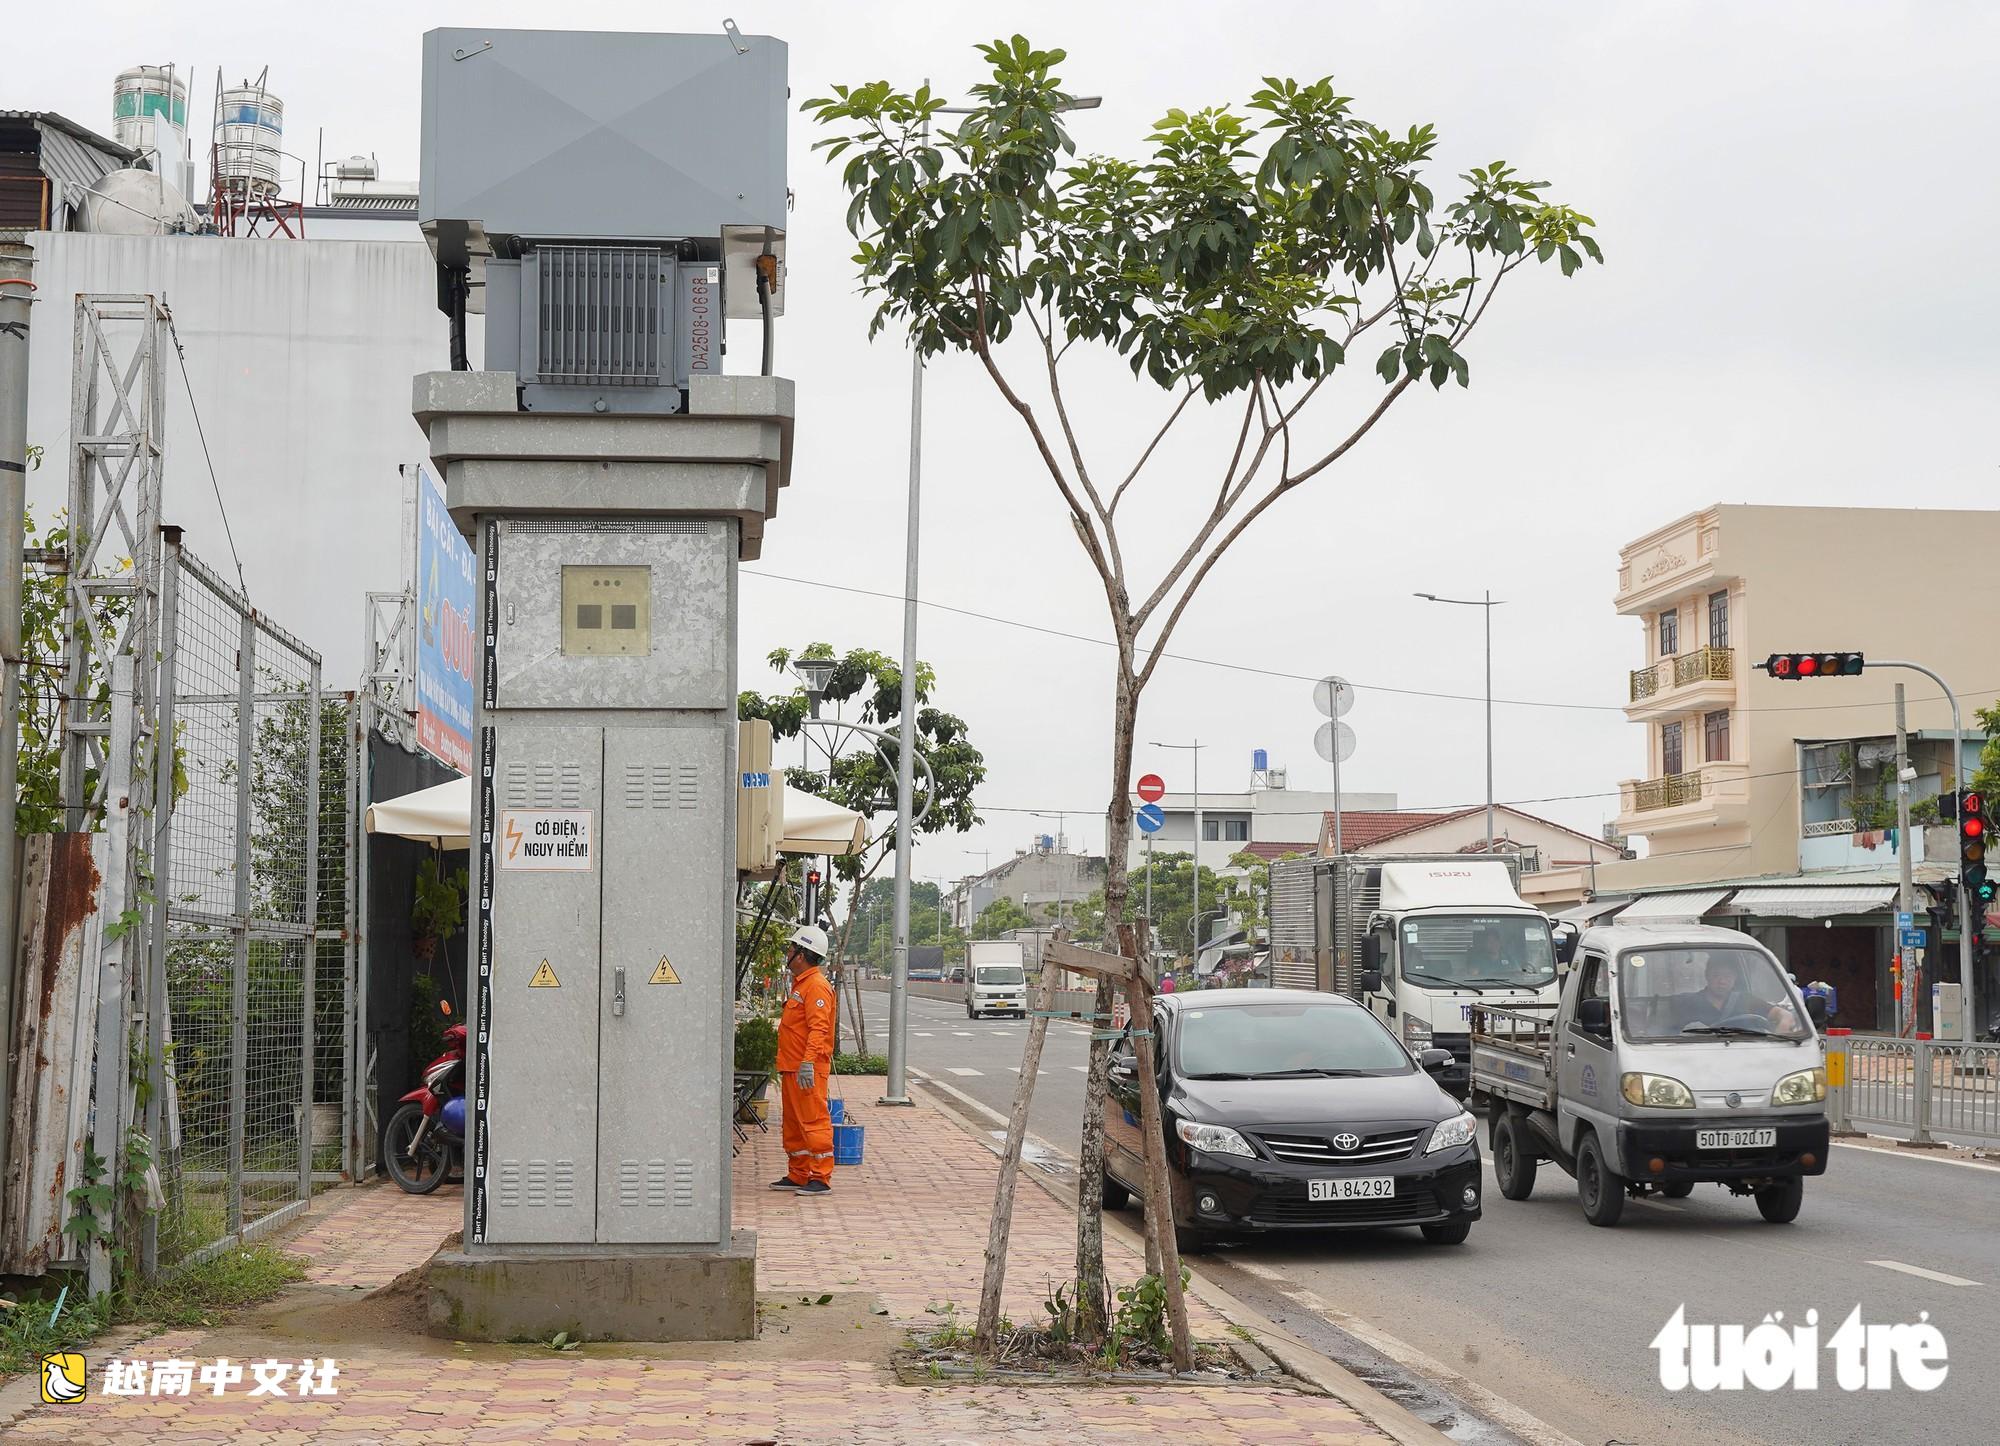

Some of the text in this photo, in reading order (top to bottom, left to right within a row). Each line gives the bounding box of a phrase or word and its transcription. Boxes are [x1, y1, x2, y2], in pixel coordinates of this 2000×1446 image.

[440, 520, 455, 560] CÁT
[535, 819, 578, 838] CÓ ĐIỆN
[524, 838, 588, 857] NGUY HIỂM!
[1701, 1131, 1772, 1147] 50TD-020.17
[1311, 1180, 1392, 1199] 51A-842.92
